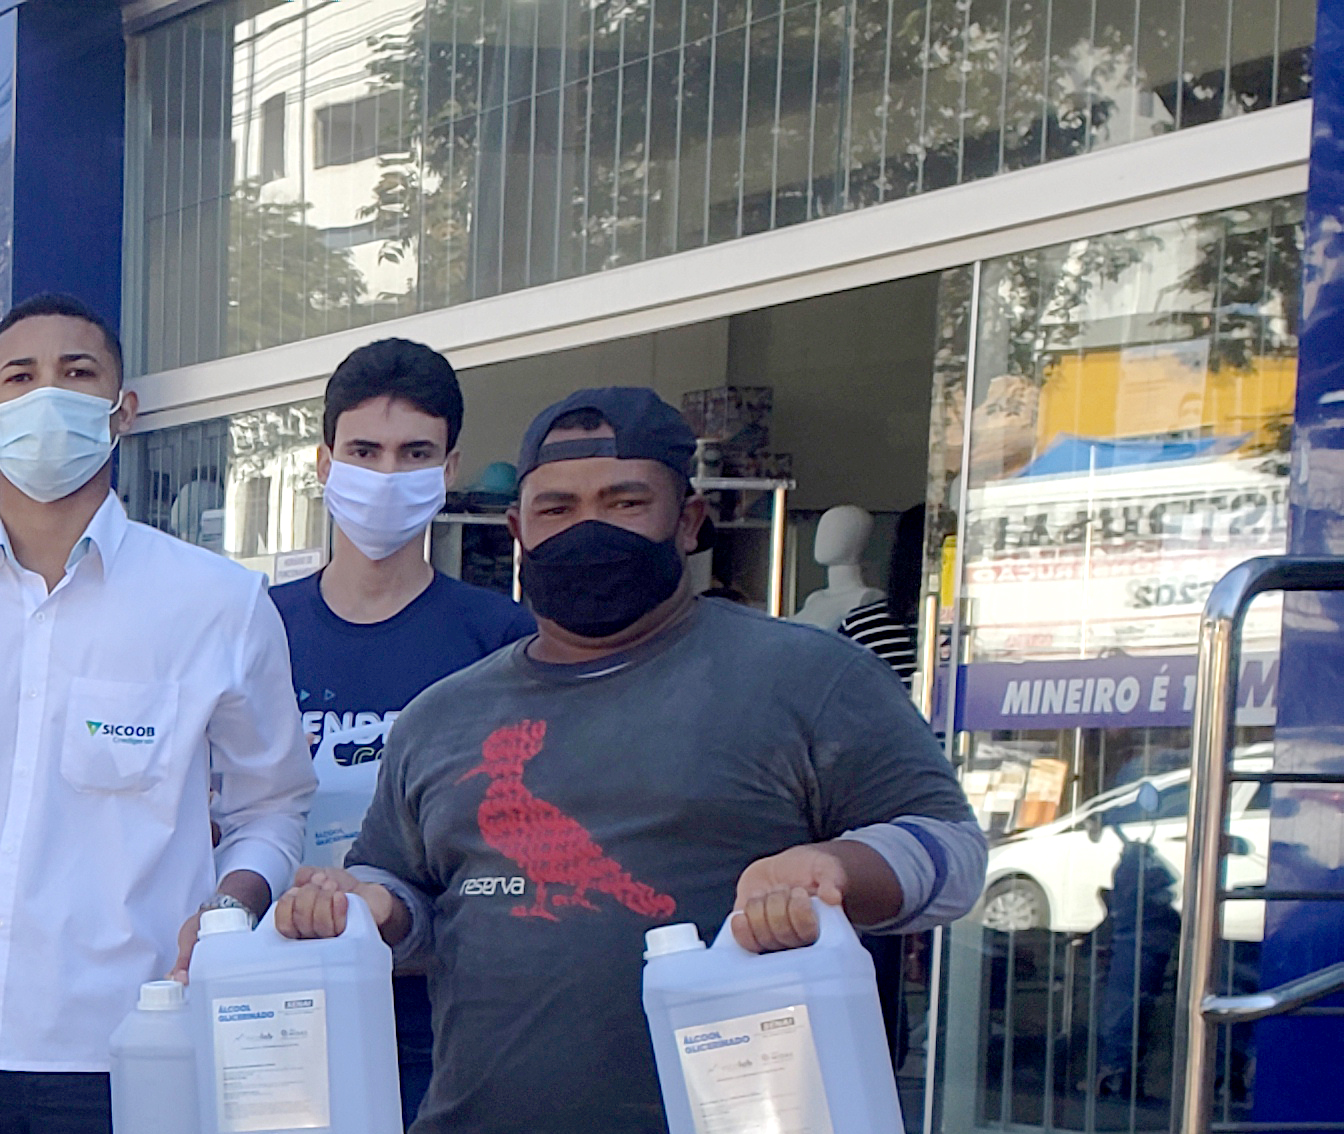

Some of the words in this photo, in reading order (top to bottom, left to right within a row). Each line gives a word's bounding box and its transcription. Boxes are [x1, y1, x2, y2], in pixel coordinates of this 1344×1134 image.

[1001, 676, 1140, 715] MINEIRO
[1149, 664, 1170, 712] É
[102, 724, 155, 737] SICOOB
[459, 877, 525, 896] reserva
